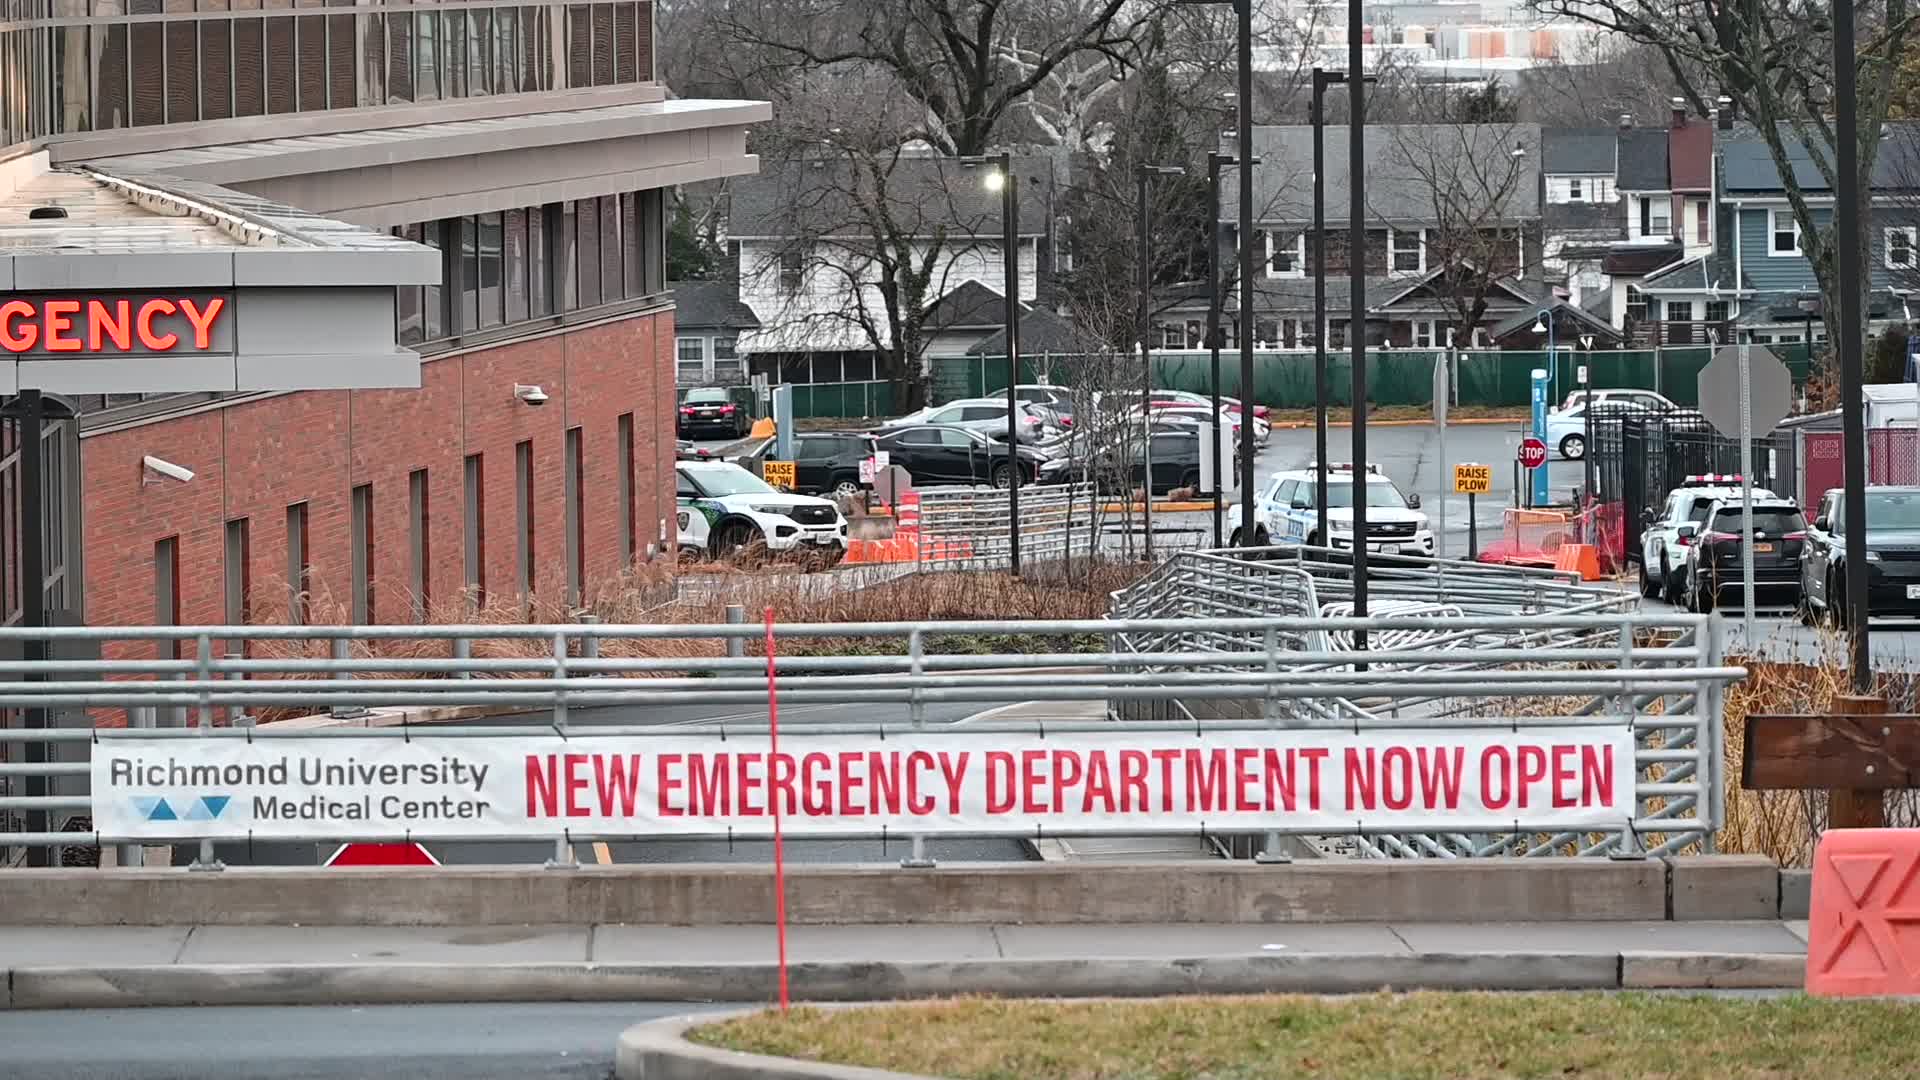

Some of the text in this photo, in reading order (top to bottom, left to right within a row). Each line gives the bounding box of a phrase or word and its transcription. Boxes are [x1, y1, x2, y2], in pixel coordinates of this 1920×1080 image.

[0, 298, 225, 352] GENCY
[1519, 447, 1544, 459] STOP
[765, 464, 793, 475] RAISE
[1457, 467, 1488, 479] RAISE
[1458, 479, 1487, 490] PLOW
[111, 756, 489, 791] Richmond University
[526, 744, 1614, 818] NEW EMERGENCY DEPARTMENT NOW OPEN
[253, 796, 490, 820] Medical Center
